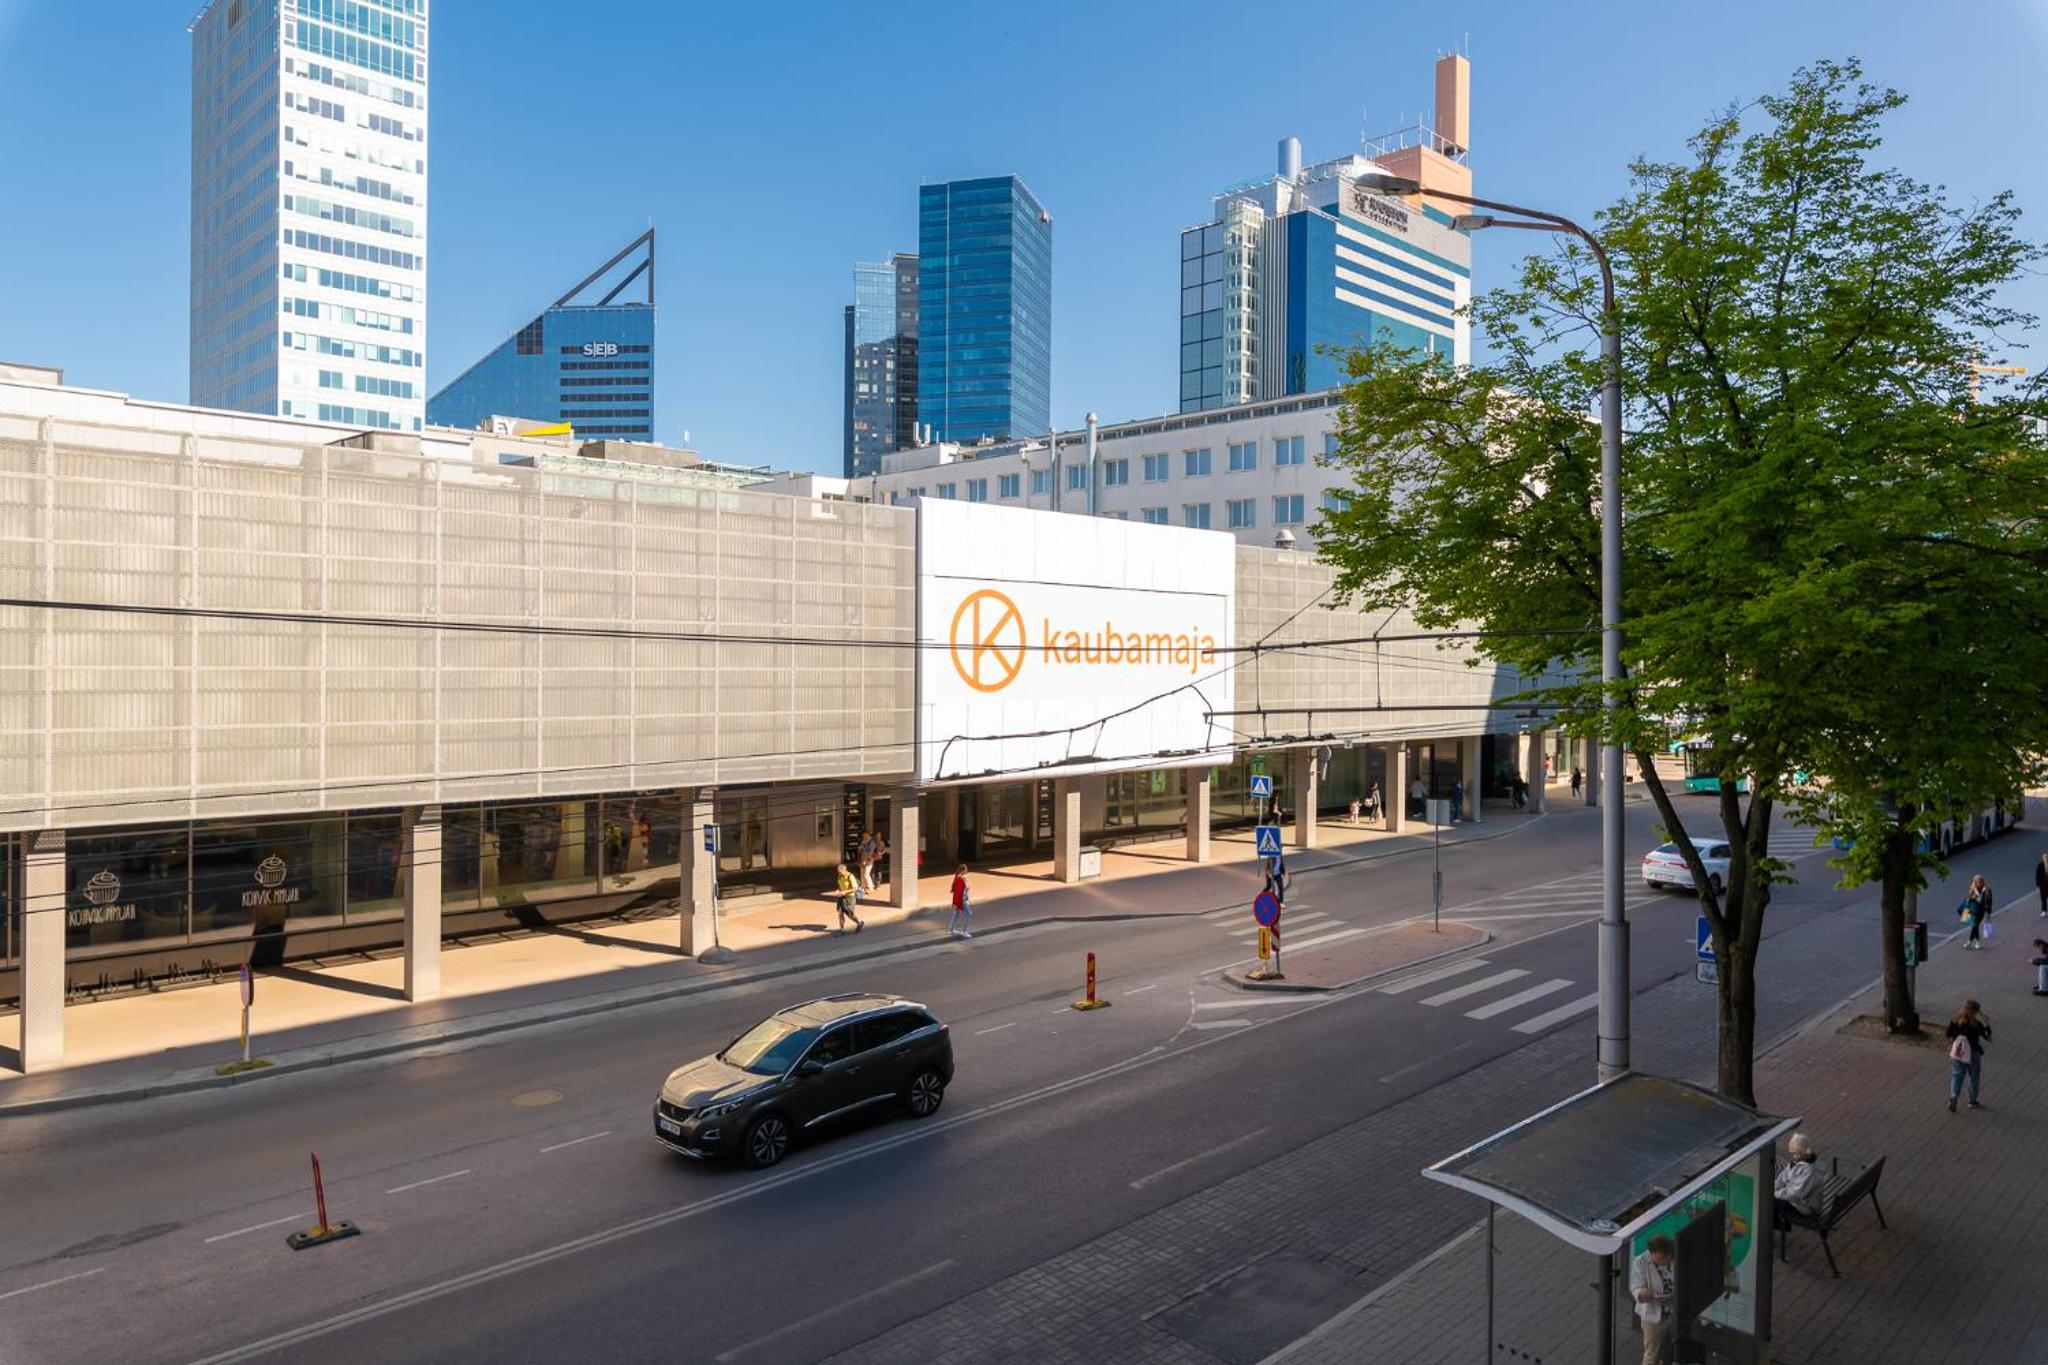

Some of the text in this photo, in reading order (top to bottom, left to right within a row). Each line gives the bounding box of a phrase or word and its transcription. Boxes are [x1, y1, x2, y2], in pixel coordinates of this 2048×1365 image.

[583, 342, 618, 357] SEB
[492, 415, 518, 436] EY
[1043, 618, 1215, 674] kaubamaja
